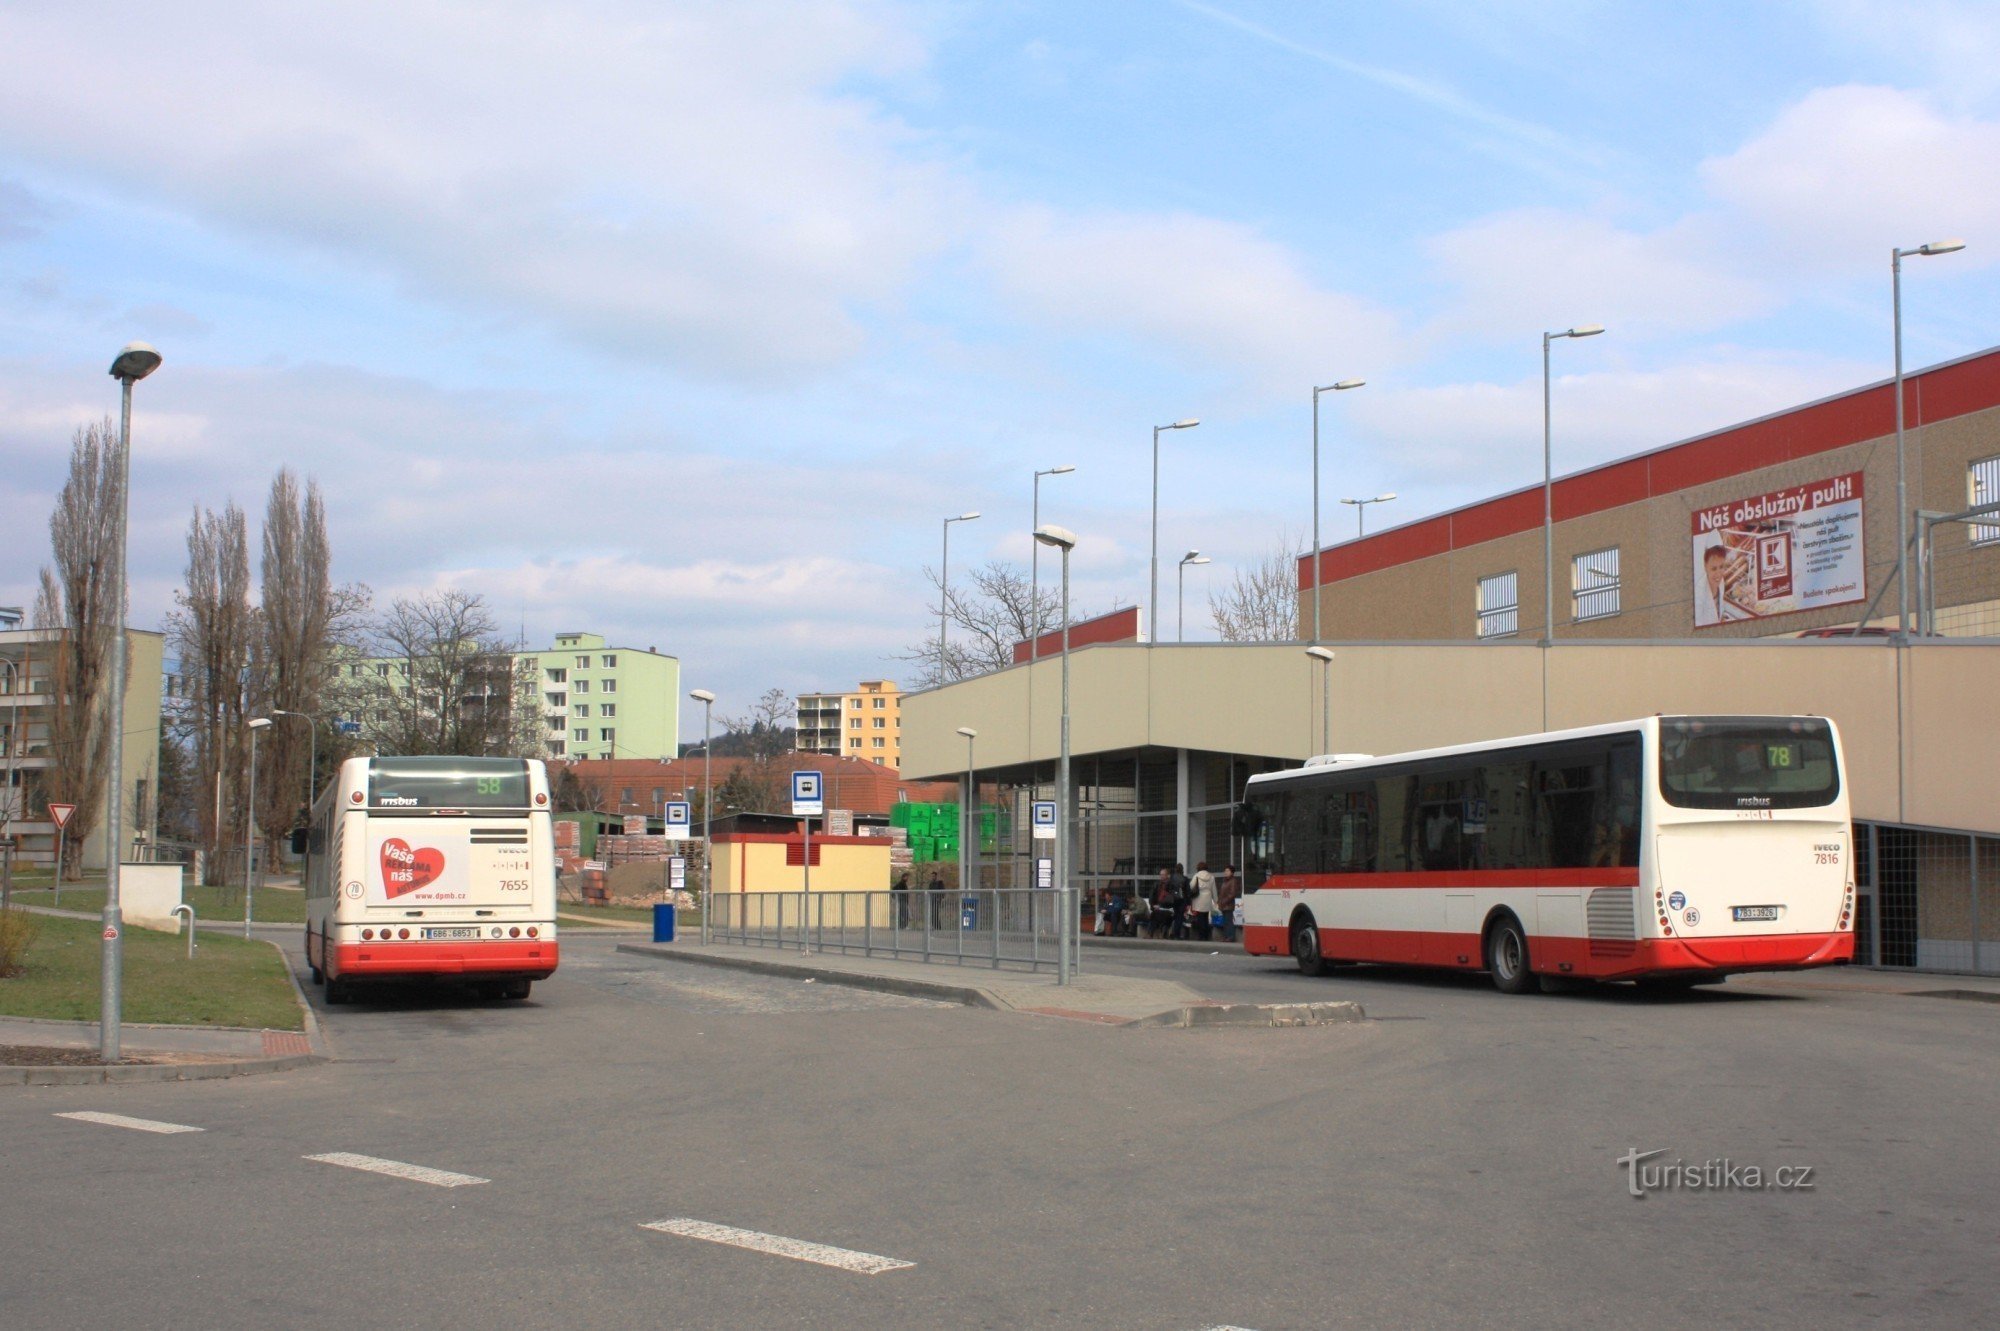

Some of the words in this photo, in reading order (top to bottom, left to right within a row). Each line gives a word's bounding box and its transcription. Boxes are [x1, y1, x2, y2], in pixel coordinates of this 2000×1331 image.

[1700, 505, 1730, 531] Náš
[1734, 487, 1808, 523] obslužný
[1812, 477, 1852, 510] pult!
[1803, 589, 1824, 599] Budete
[1768, 746, 1790, 767] 78
[477, 776, 500, 794] 58
[1737, 796, 1771, 806] irisbus
[384, 842, 415, 864] Vaše
[1814, 853, 1839, 864] 7816
[385, 859, 431, 873] REKLAMA
[390, 868, 414, 882] náš
[499, 880, 529, 891] 7655
[415, 892, 466, 901] www.dpmb.cz
[1686, 912, 1697, 922] 85
